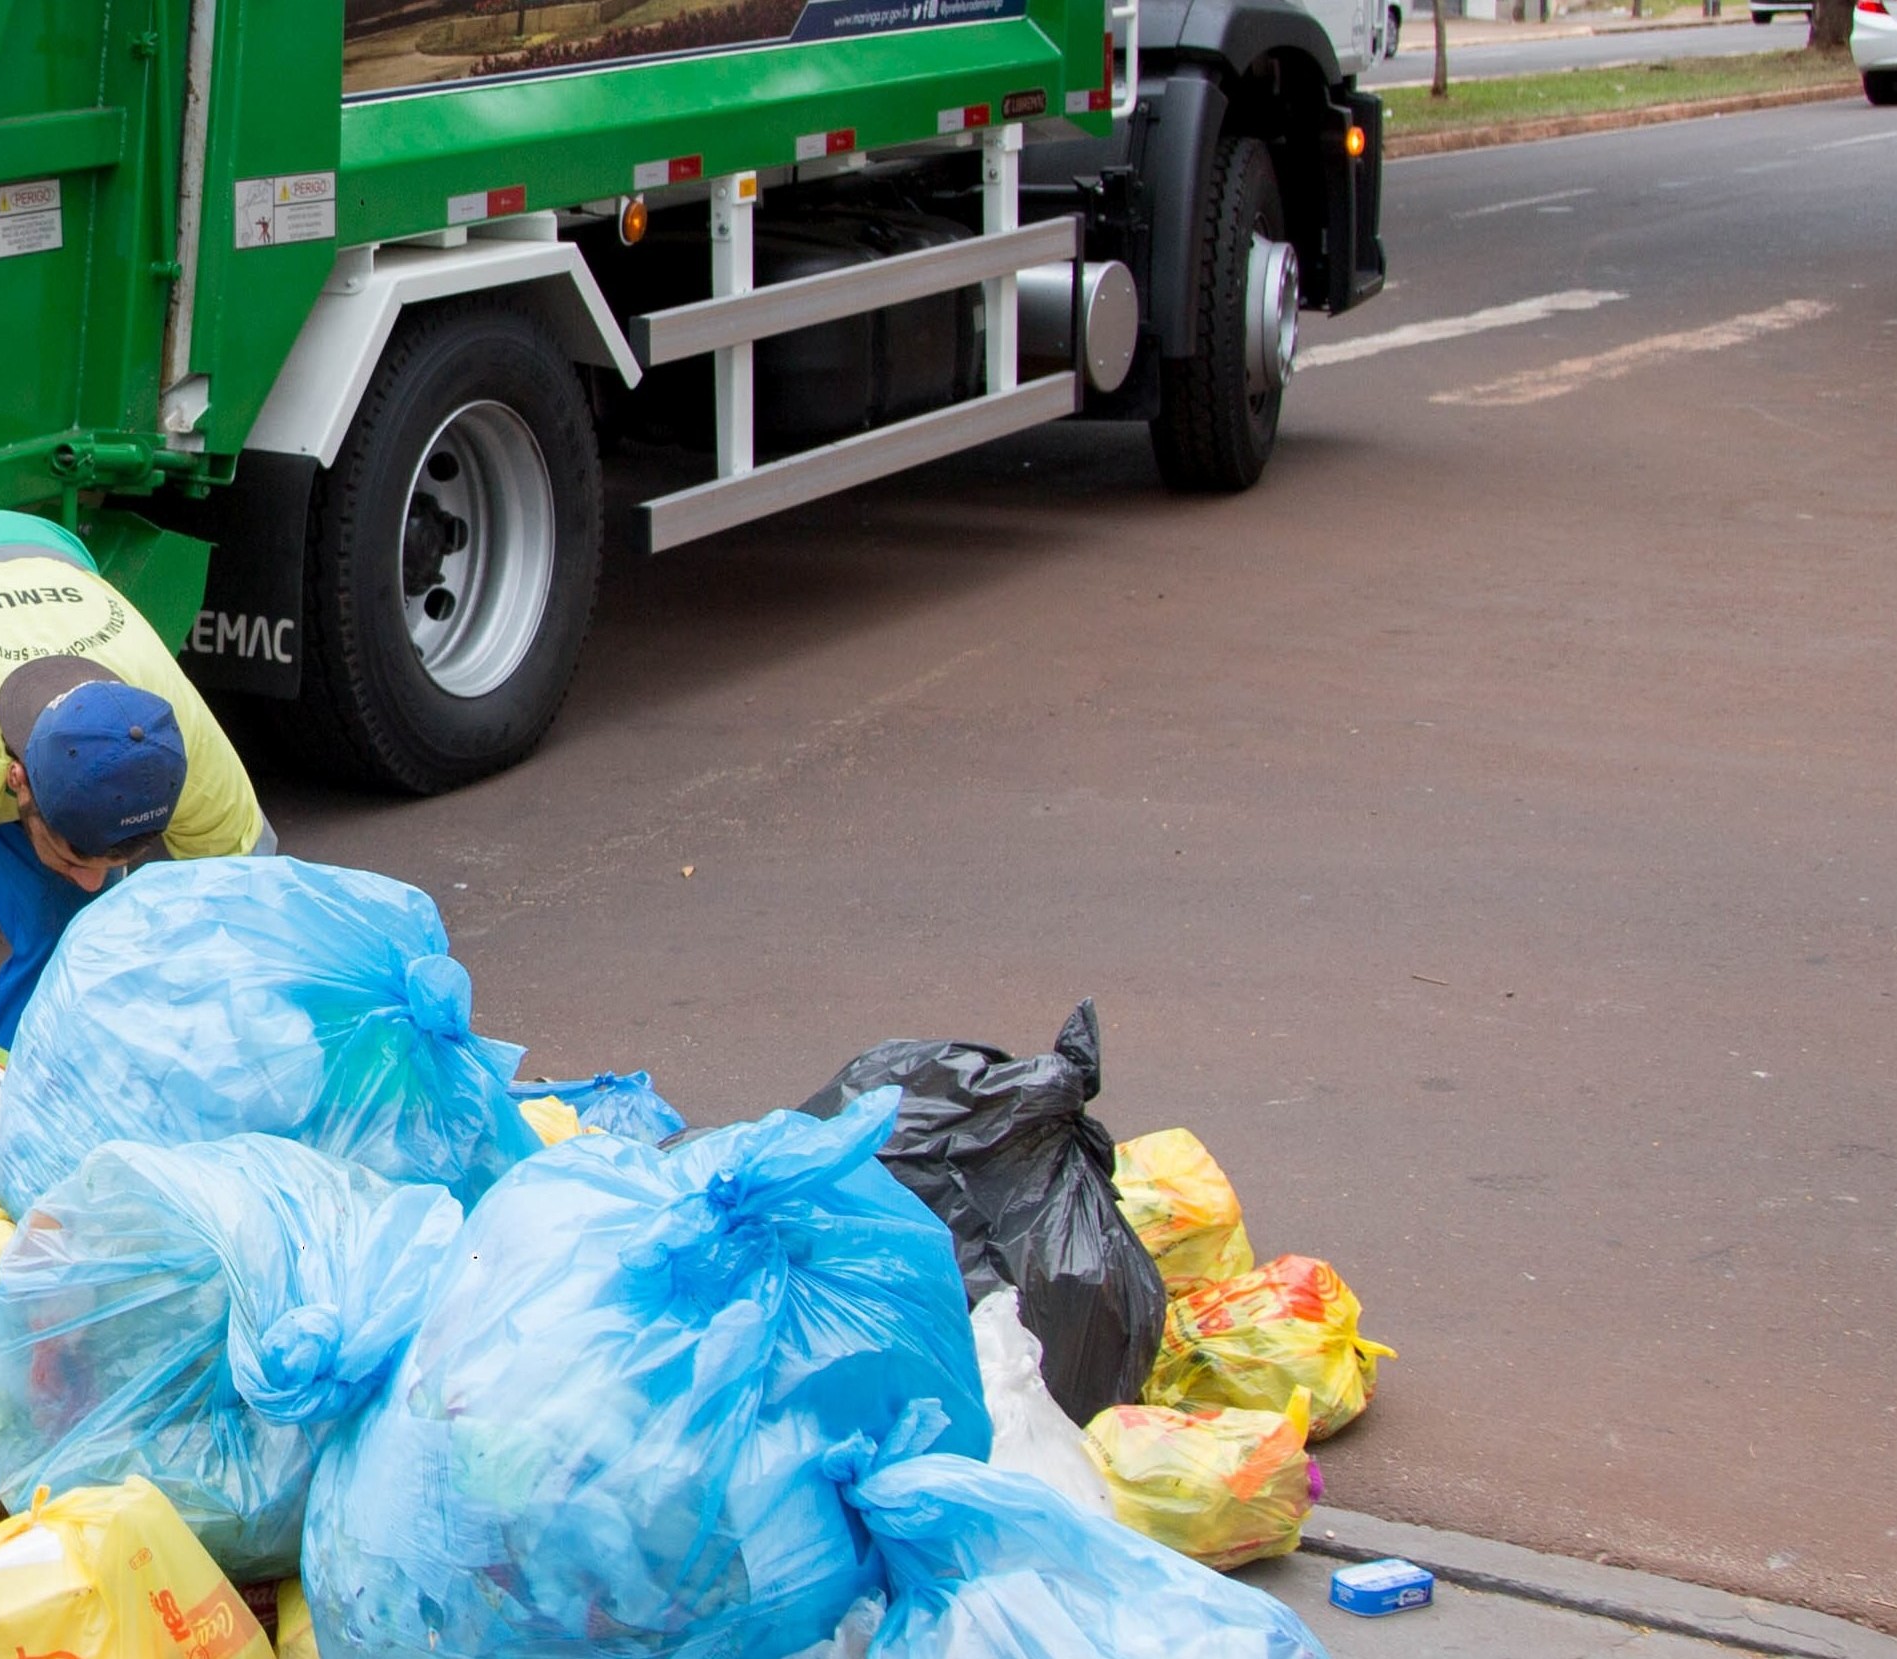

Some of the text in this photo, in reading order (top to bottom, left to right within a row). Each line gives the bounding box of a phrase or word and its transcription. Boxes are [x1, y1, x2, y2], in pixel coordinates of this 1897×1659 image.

[14, 188, 52, 206] PERIGO
[294, 180, 327, 197] PERIGO
[182, 610, 295, 664] EMAC
[120, 805, 169, 827] HOUSTON
